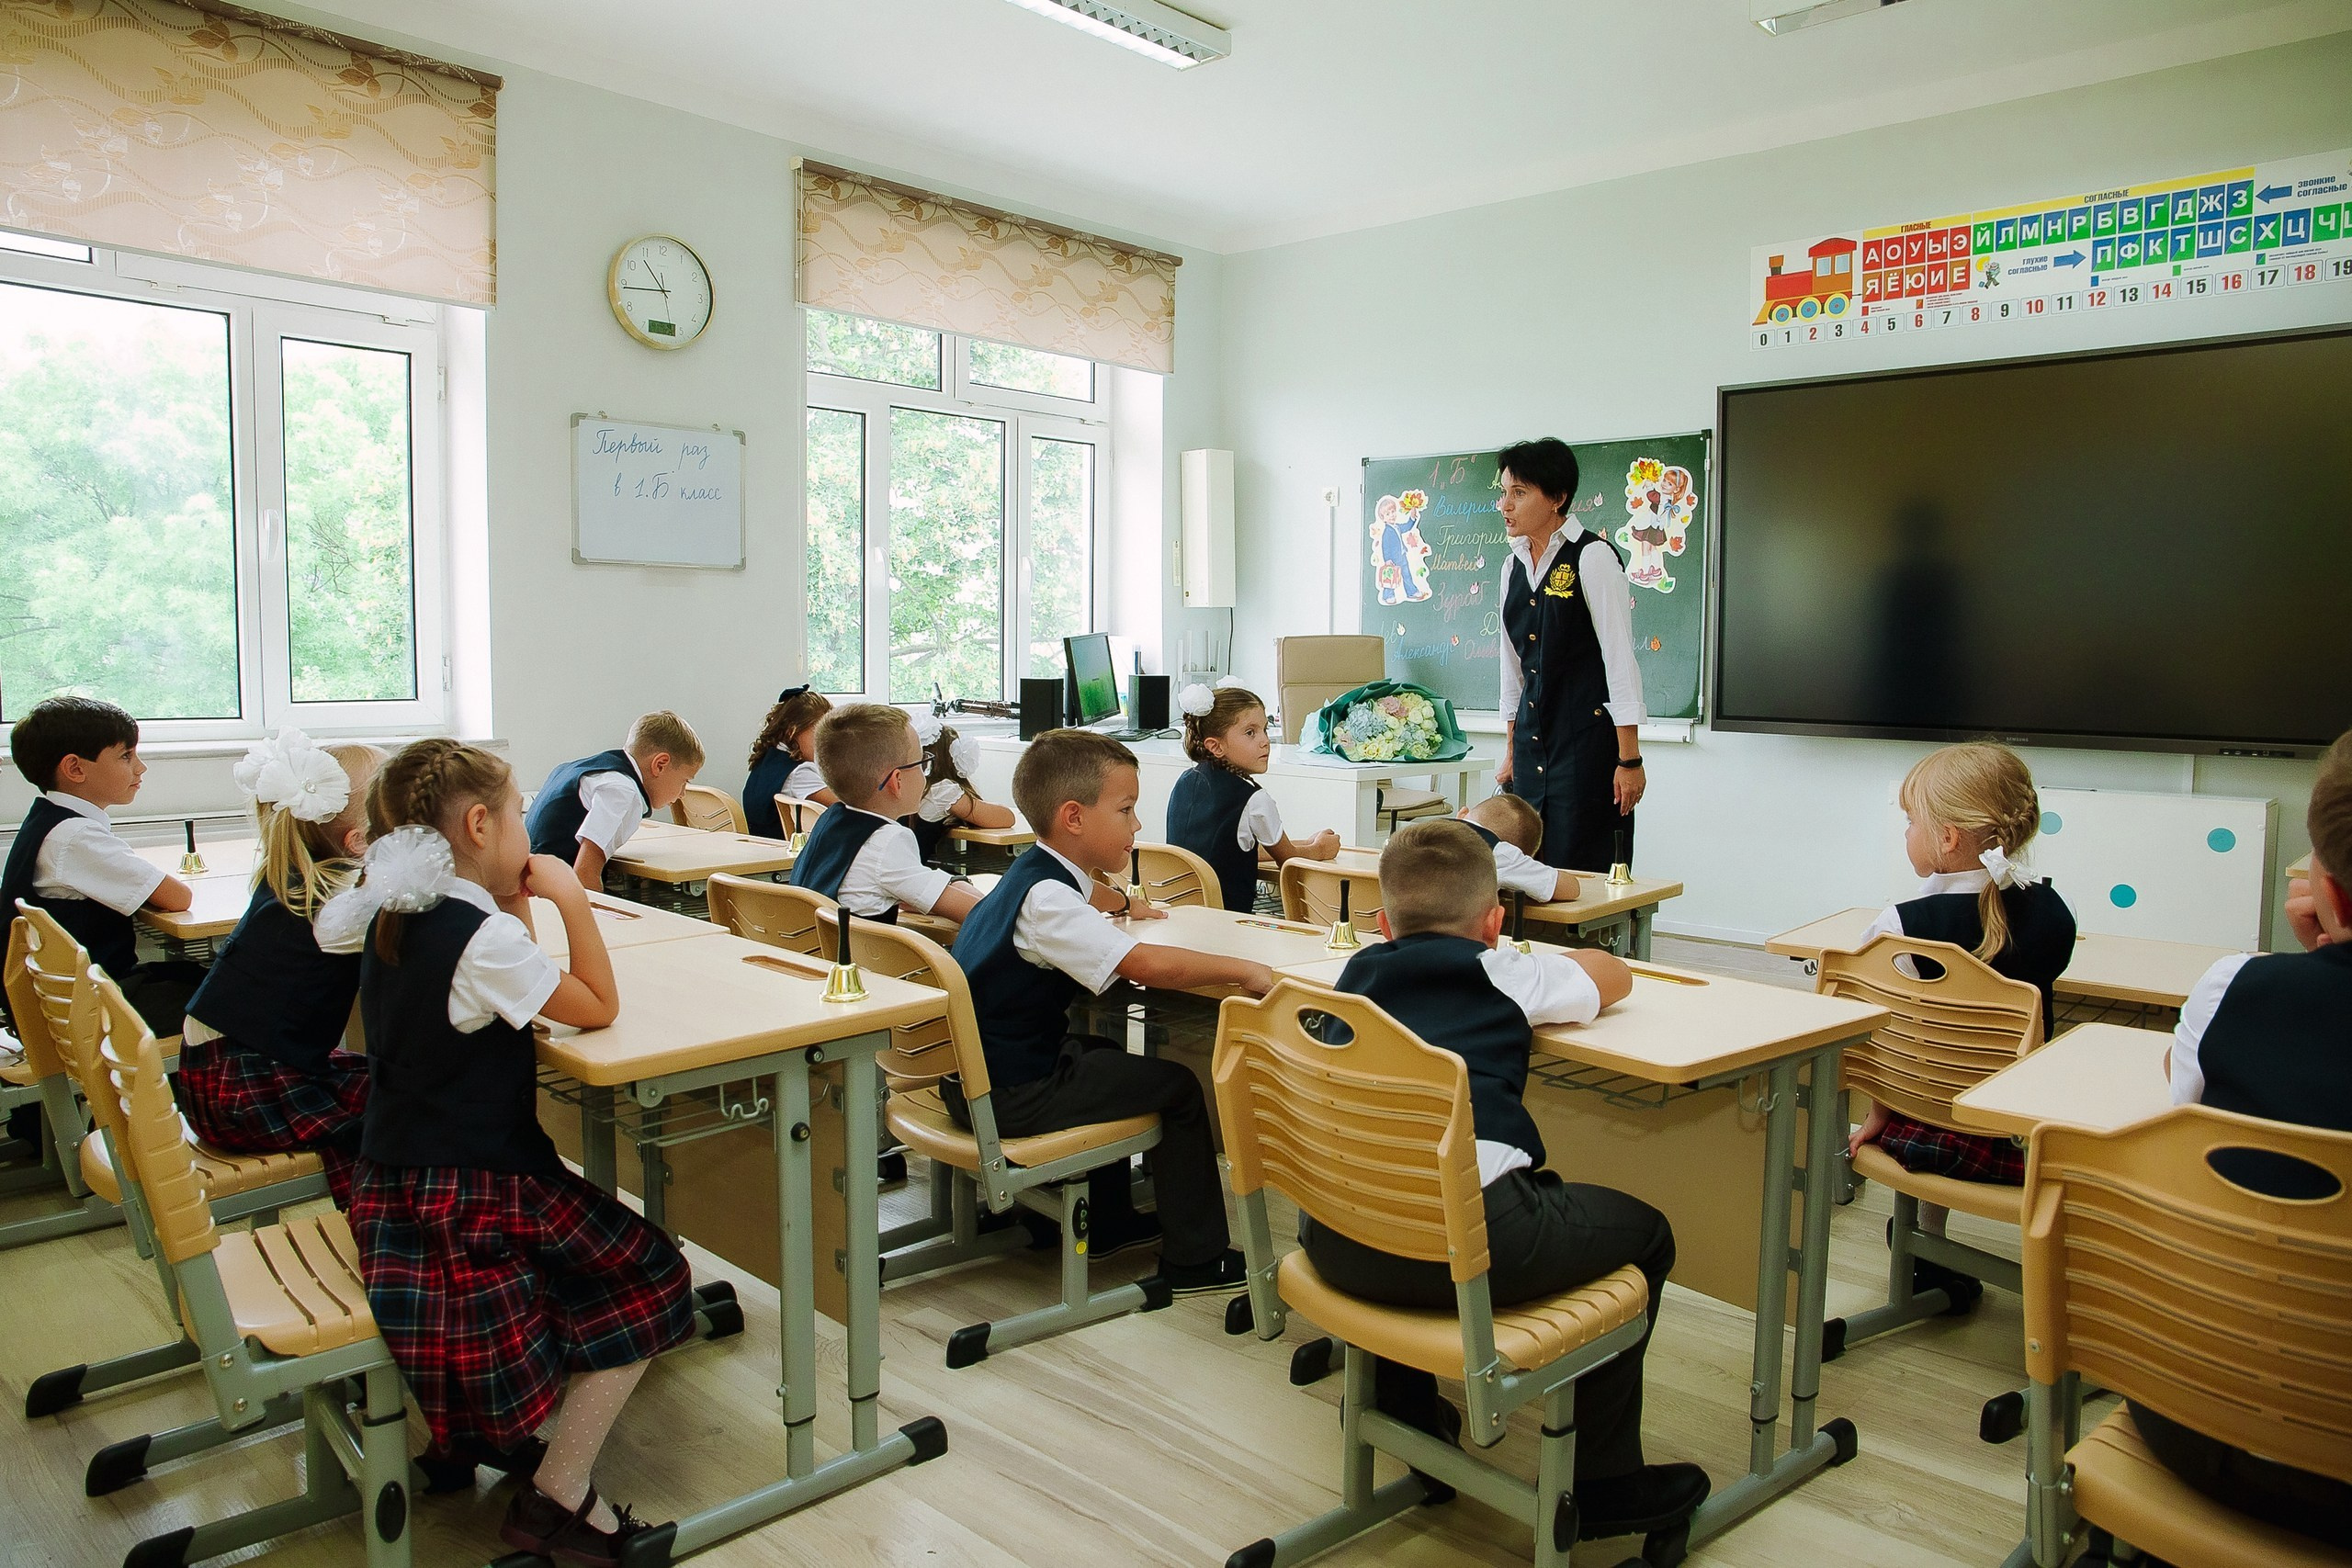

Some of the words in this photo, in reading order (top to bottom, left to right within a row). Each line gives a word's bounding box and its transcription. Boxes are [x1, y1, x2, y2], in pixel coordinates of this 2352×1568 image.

[2084, 188, 2130, 204] СОГЛАСНЫЕ
[1976, 226, 1990, 248] Й
[1999, 226, 2014, 244] Л
[2021, 222, 2038, 240] М
[2047, 219, 2062, 237] Н
[2073, 215, 2086, 233] Р
[2098, 211, 2112, 230] Б
[2123, 207, 2139, 225] В
[2151, 203, 2165, 220] Г
[2175, 198, 2193, 220] Д
[2199, 193, 2223, 213] Ж
[2233, 189, 2247, 209] З
[1901, 220, 1932, 233] ГЛАСНЫЕ
[2097, 246, 2111, 264] П
[2120, 242, 2139, 259] Ф
[2148, 239, 2163, 256] К
[2175, 233, 2191, 252] Т
[2199, 230, 2222, 249] Ш
[2229, 226, 2247, 244] С
[2258, 221, 2277, 241] Х
[2287, 217, 2305, 239] Ц
[2319, 213, 2335, 231] Ч
[642, 247, 649, 257] 11
[659, 245, 668, 257] 12
[1865, 248, 1880, 265] А
[1886, 244, 1902, 261] О
[1909, 241, 1923, 257] У
[1928, 238, 1948, 254] Ы
[1952, 234, 1968, 251] Э
[627, 259, 637, 271] 10
[691, 272, 698, 283] 2
[1865, 279, 1880, 297] Я
[1887, 273, 1900, 292] Ё
[1905, 272, 1925, 289] Ю
[1931, 269, 1944, 287] И
[1953, 266, 1966, 283] Е
[698, 294, 704, 303] 3
[1760, 333, 1768, 346] 0
[1785, 331, 1791, 344] 1
[1809, 327, 1817, 340] 2
[1835, 324, 1843, 337] 3
[1861, 321, 1869, 334] 4
[1887, 318, 1896, 331] 5
[1915, 314, 1923, 327] 6
[1942, 310, 1951, 325] 7
[1972, 307, 1980, 321] 8
[2001, 303, 2009, 318] 9
[2026, 299, 2044, 314] 10
[2057, 296, 2073, 310] 11
[2087, 291, 2107, 307] 12
[2120, 287, 2139, 303] 13
[2153, 283, 2172, 299] 14
[2187, 279, 2207, 294] 15
[2222, 274, 2242, 290] 16
[2258, 269, 2278, 286] 17
[2295, 265, 2316, 281] 18
[2332, 259, 2352, 276] 19
[627, 301, 632, 311] 8
[691, 314, 696, 322] 4
[680, 327, 684, 336] 5
[593, 428, 664, 463] Первый
[678, 442, 710, 470] раз
[614, 472, 622, 497] в
[680, 487, 722, 501] класс
[1433, 494, 1498, 523] Валерия
